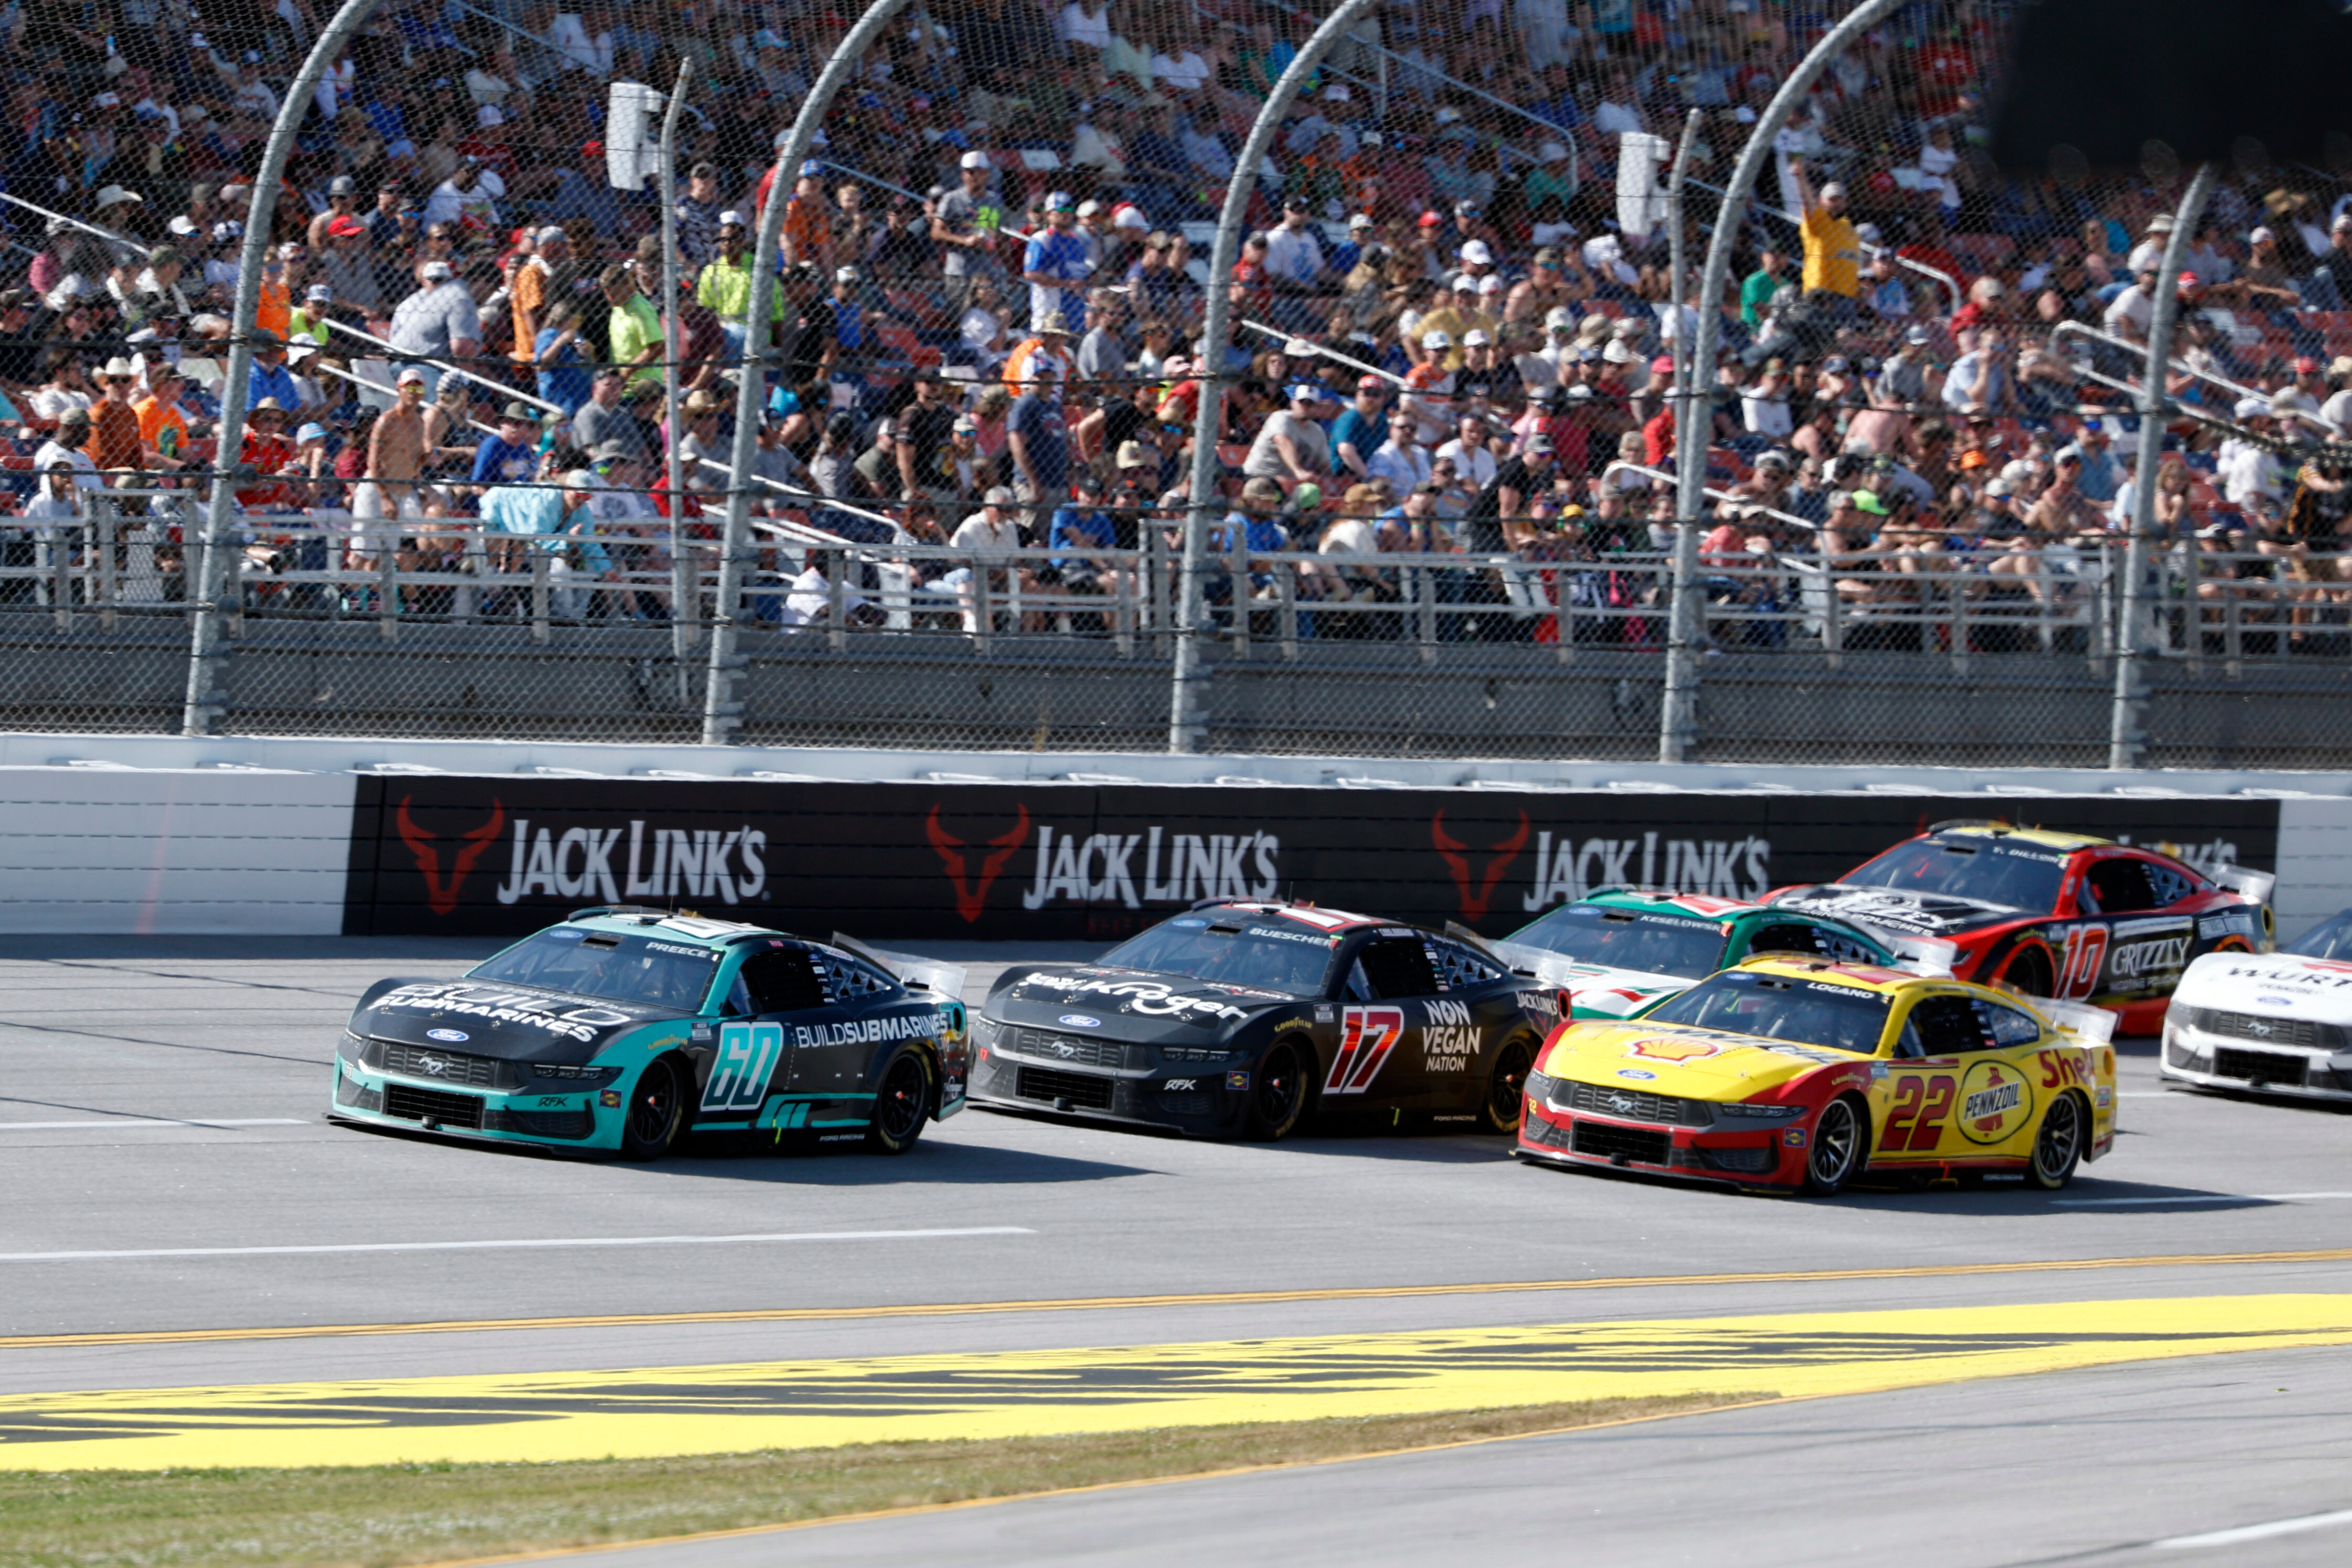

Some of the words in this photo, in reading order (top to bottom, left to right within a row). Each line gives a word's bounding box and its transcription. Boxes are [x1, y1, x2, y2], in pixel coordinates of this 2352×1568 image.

[497, 818, 623, 904] JACK
[624, 820, 767, 904] LINK'S
[1023, 825, 1143, 910] JACK
[1144, 826, 1280, 902] LINK'S
[1523, 831, 1638, 913] JACK
[1643, 831, 1771, 903] LINK'S
[2008, 848, 2059, 863] DILLON
[1851, 912, 1936, 937] POUCHES
[646, 942, 710, 958] PREECE
[2055, 921, 2110, 1001] 10
[2111, 936, 2192, 978] GRIZZLY
[1078, 980, 1249, 1020] Kroger
[1807, 982, 1875, 999] LOGANO
[367, 996, 598, 1043] SUBMARINES
[795, 1012, 949, 1049] BUILDSUBMARINES
[1422, 999, 1472, 1026] NON
[1322, 1005, 1405, 1095] 17
[1422, 1026, 1482, 1055] VEGAN
[699, 1021, 784, 1112] 60
[1425, 1055, 1467, 1072] NATION
[537, 1096, 569, 1107] RFK
[1163, 1079, 1197, 1091] RFK
[1963, 1082, 2020, 1121] PENNZOIL
[1877, 1074, 1957, 1151] 22
